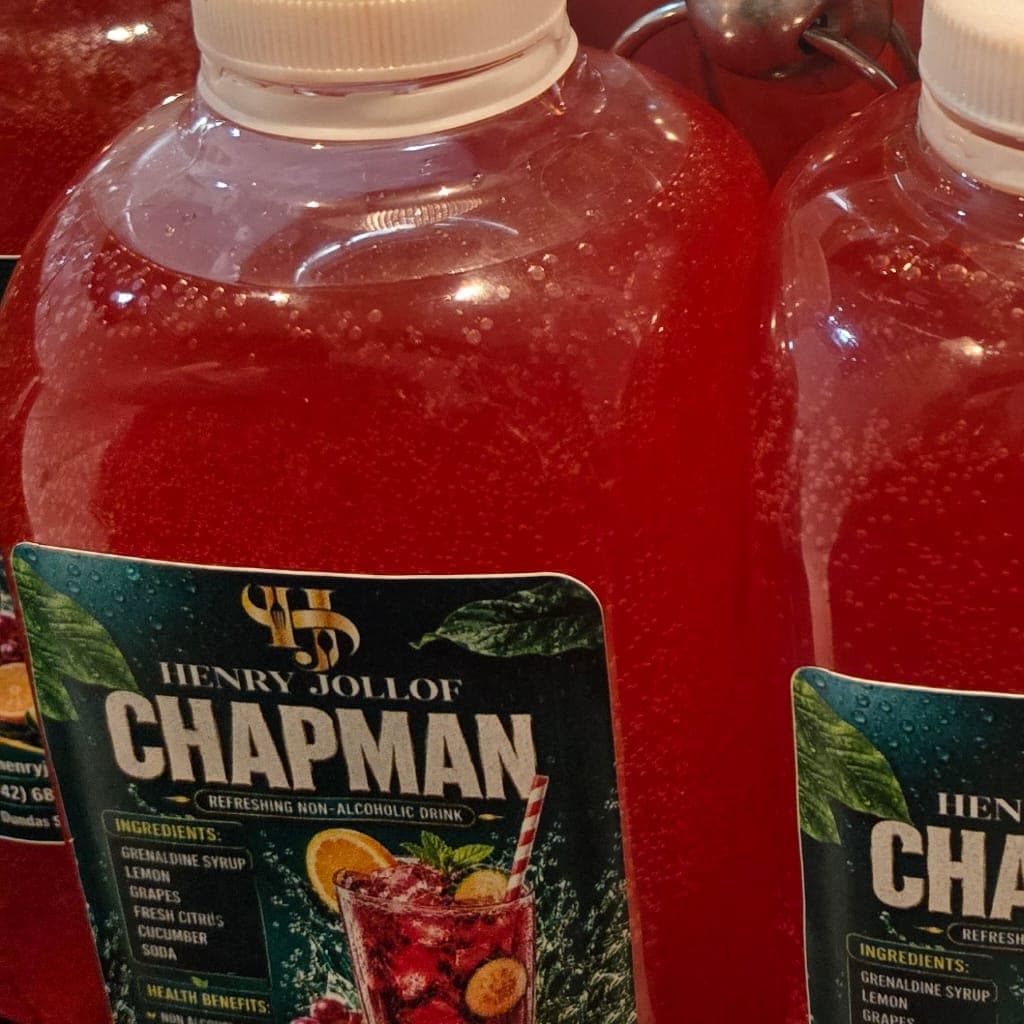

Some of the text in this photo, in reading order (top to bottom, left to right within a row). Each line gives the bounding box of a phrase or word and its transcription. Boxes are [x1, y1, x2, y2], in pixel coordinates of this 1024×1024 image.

[159, 661, 465, 703] HENRY JOLLOF
[104, 689, 541, 801] CHAPMAN
[208, 794, 464, 822] REFRESHING NON-ALCOHOLIC DRINK
[114, 817, 222, 842] INGREDIENTS:
[121, 846, 247, 871] GRENALDINE SYRUP
[124, 865, 171, 884] LEMON
[129, 885, 181, 904] GRAPES
[133, 906, 225, 928] FRESH CITRUS
[137, 925, 208, 945] CUCUMBER
[141, 944, 178, 961] SODA
[859, 943, 970, 974] INGREDIENTS:
[146, 983, 271, 1014] HEALTH BENEFITS:
[860, 970, 991, 1003] GRENALDINE SYRUP
[861, 989, 909, 1010] LEMON
